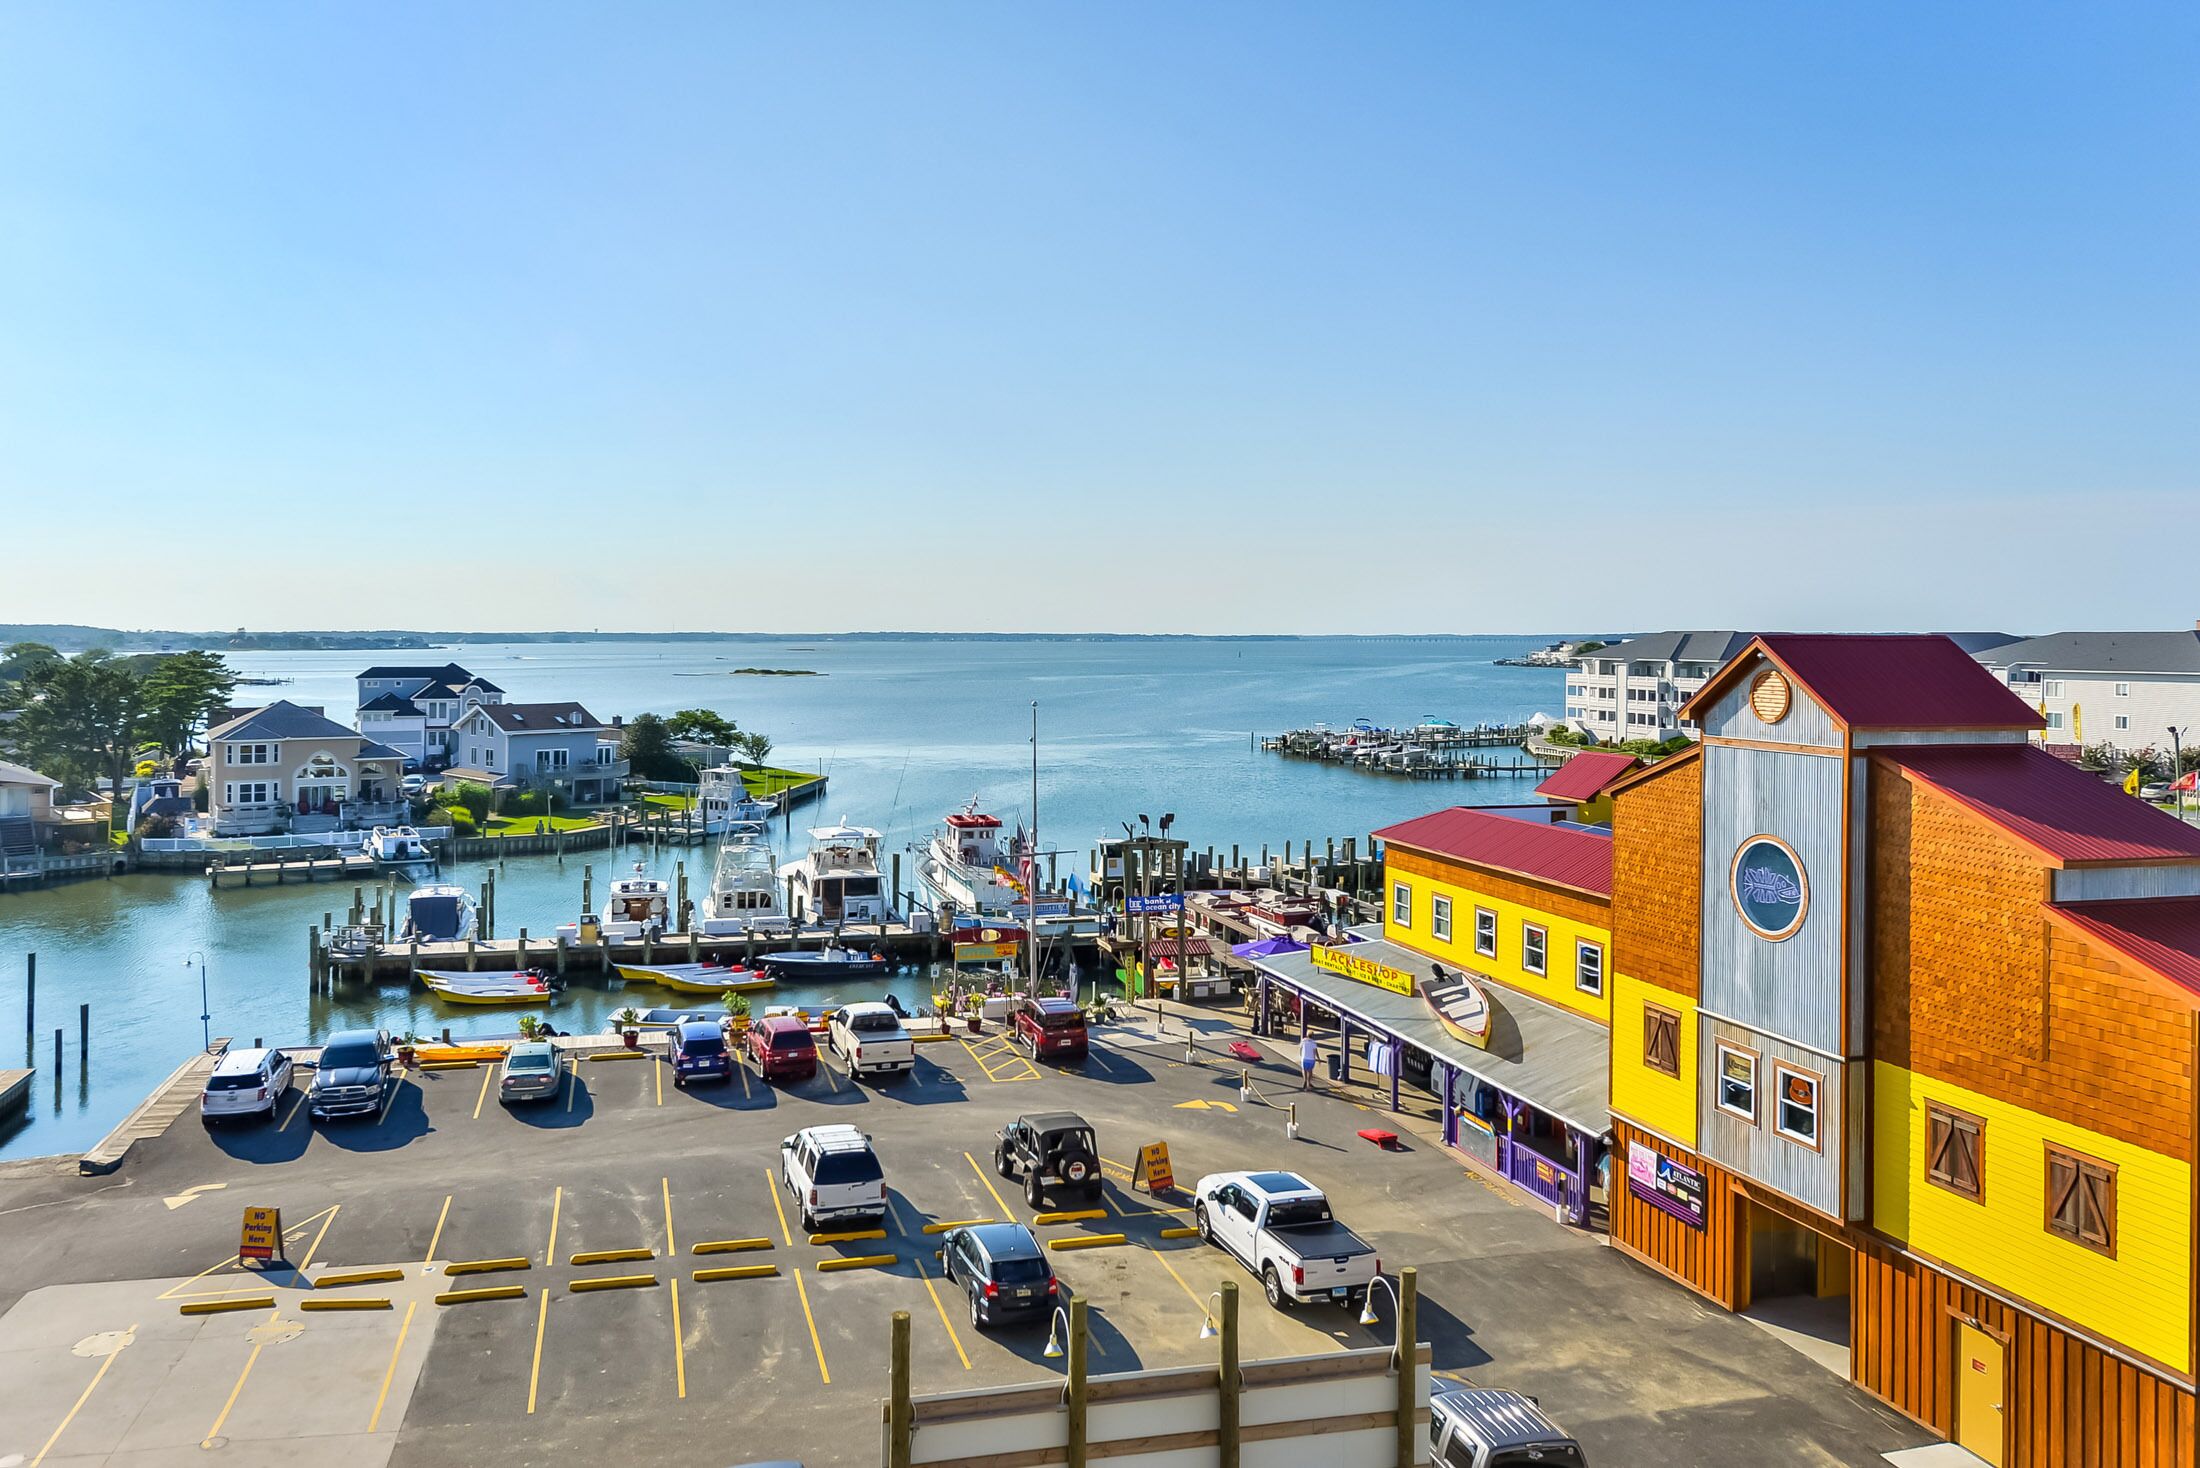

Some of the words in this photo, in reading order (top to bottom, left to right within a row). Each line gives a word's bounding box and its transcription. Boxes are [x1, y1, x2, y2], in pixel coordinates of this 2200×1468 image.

[1168, 902, 1181, 911] city
[1323, 949, 1398, 980] TACKLESHOP
[1151, 1147, 1160, 1156] NO
[1147, 1156, 1168, 1168] Parking
[254, 1212, 265, 1220] NO
[245, 1223, 272, 1234] Parking
[248, 1234, 266, 1243] Here
